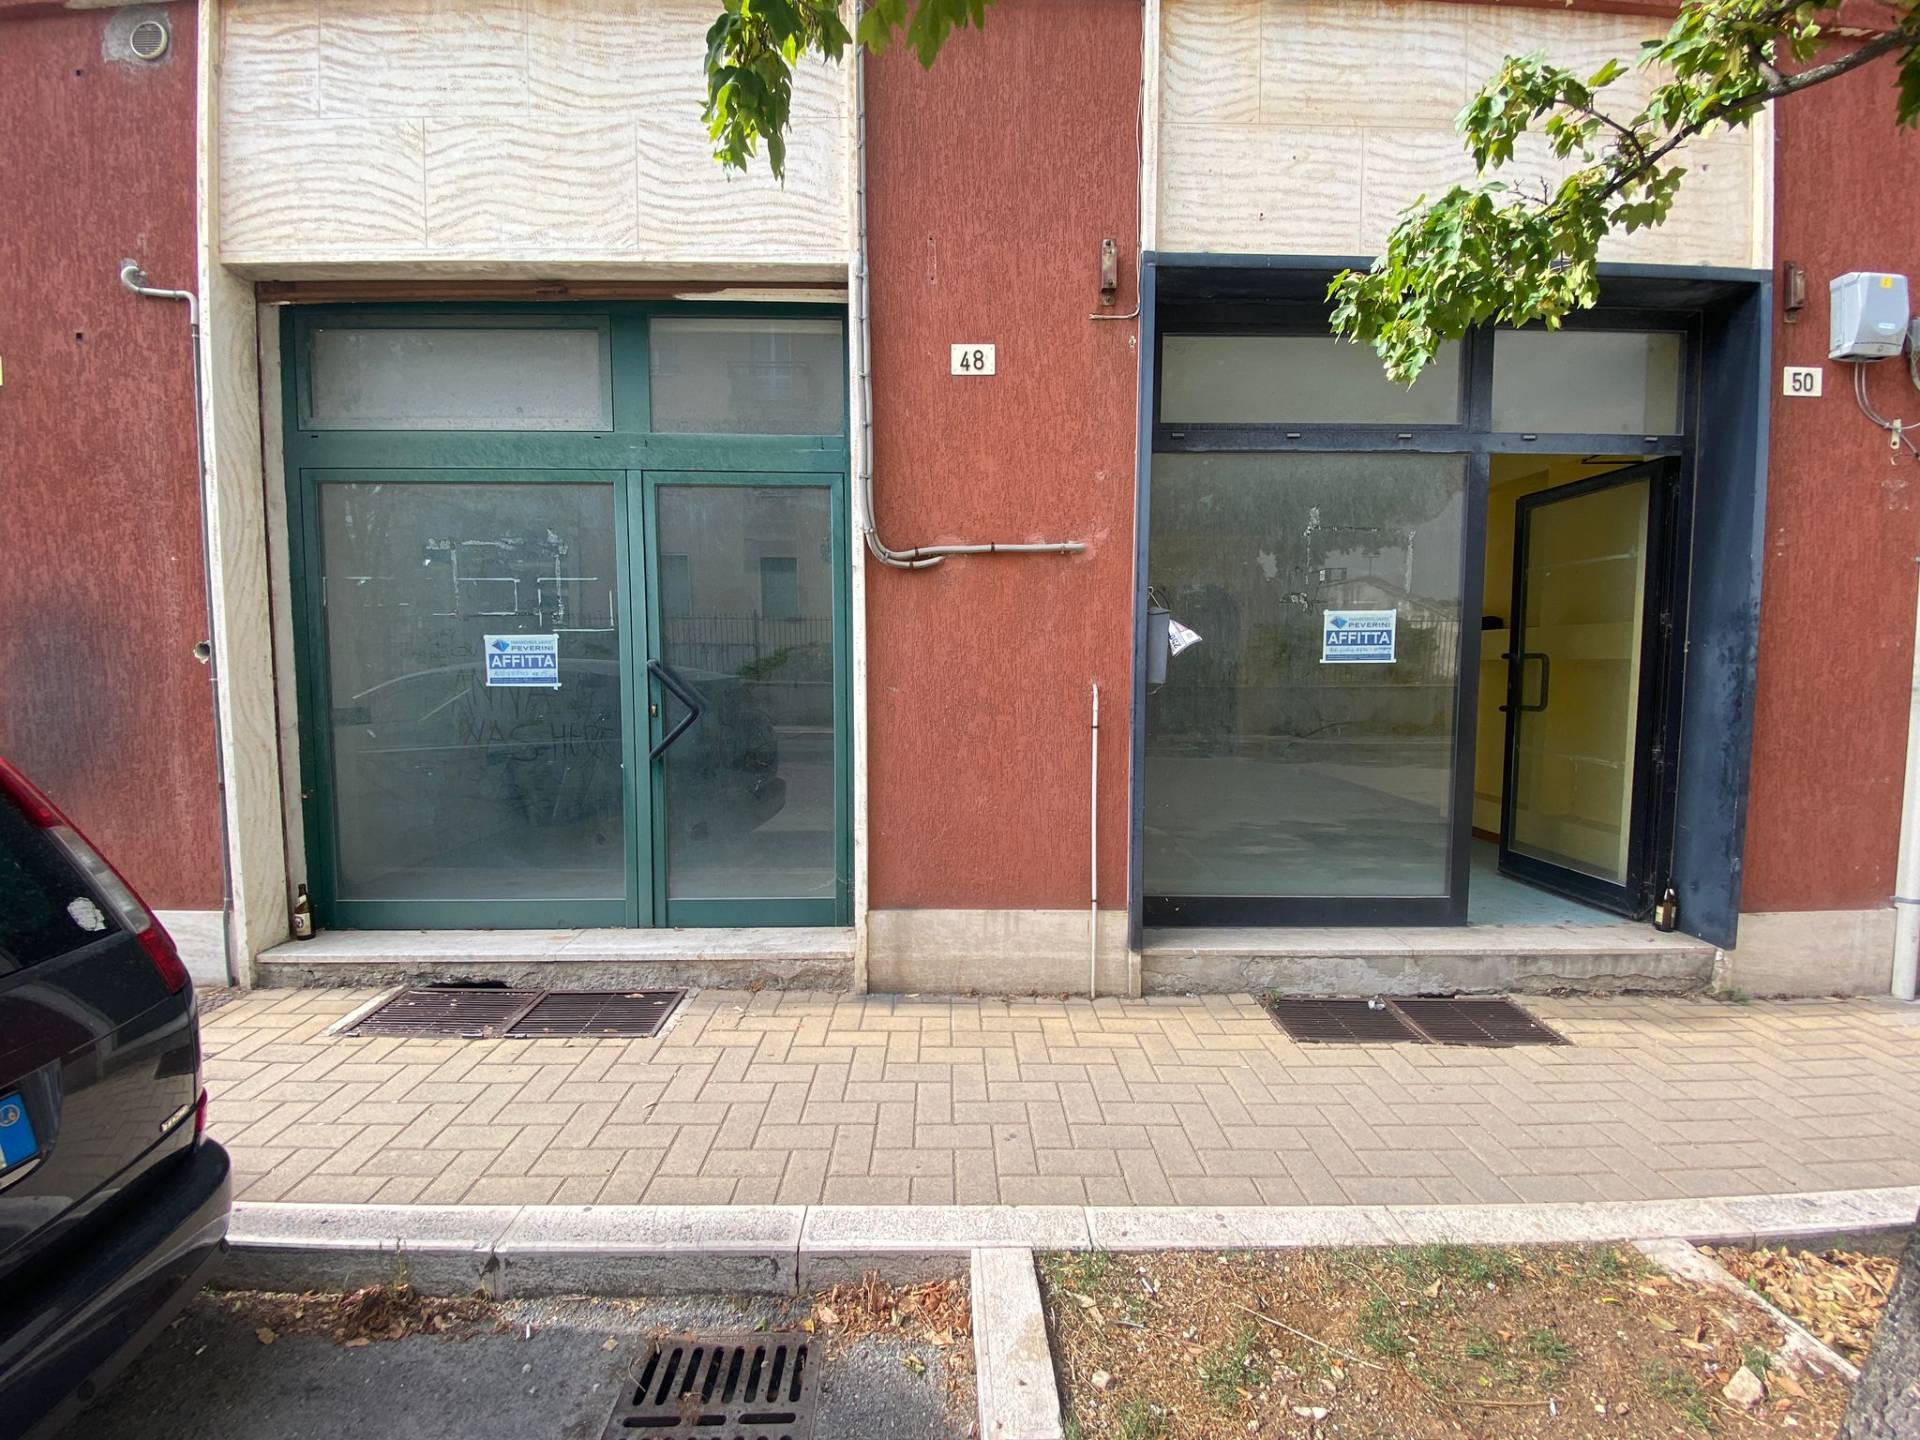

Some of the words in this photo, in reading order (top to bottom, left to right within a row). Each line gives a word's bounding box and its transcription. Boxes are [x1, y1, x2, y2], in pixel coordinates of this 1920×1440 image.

[960, 350, 984, 371] 48
[1792, 372, 1814, 392] 50
[1327, 632, 1390, 644] AFFITTA
[491, 655, 555, 668] AFFITTA
